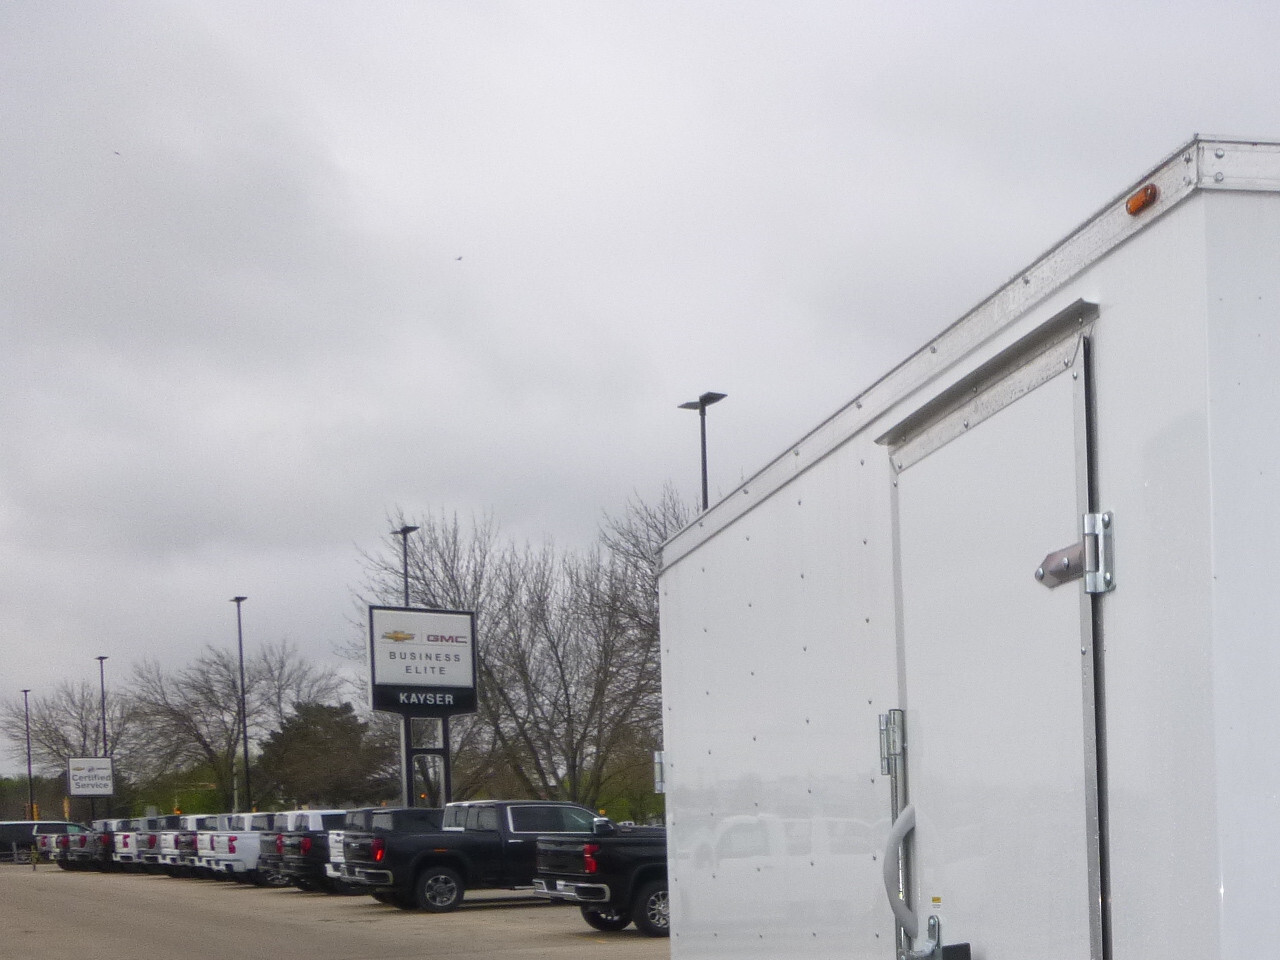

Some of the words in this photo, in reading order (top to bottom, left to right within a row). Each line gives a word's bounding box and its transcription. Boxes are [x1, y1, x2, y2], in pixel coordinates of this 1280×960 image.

[427, 634, 467, 644] GMC
[389, 651, 461, 662] BUSINESS
[405, 665, 446, 675] ELITE
[399, 692, 454, 705] KAYSER
[72, 774, 111, 782] Certified
